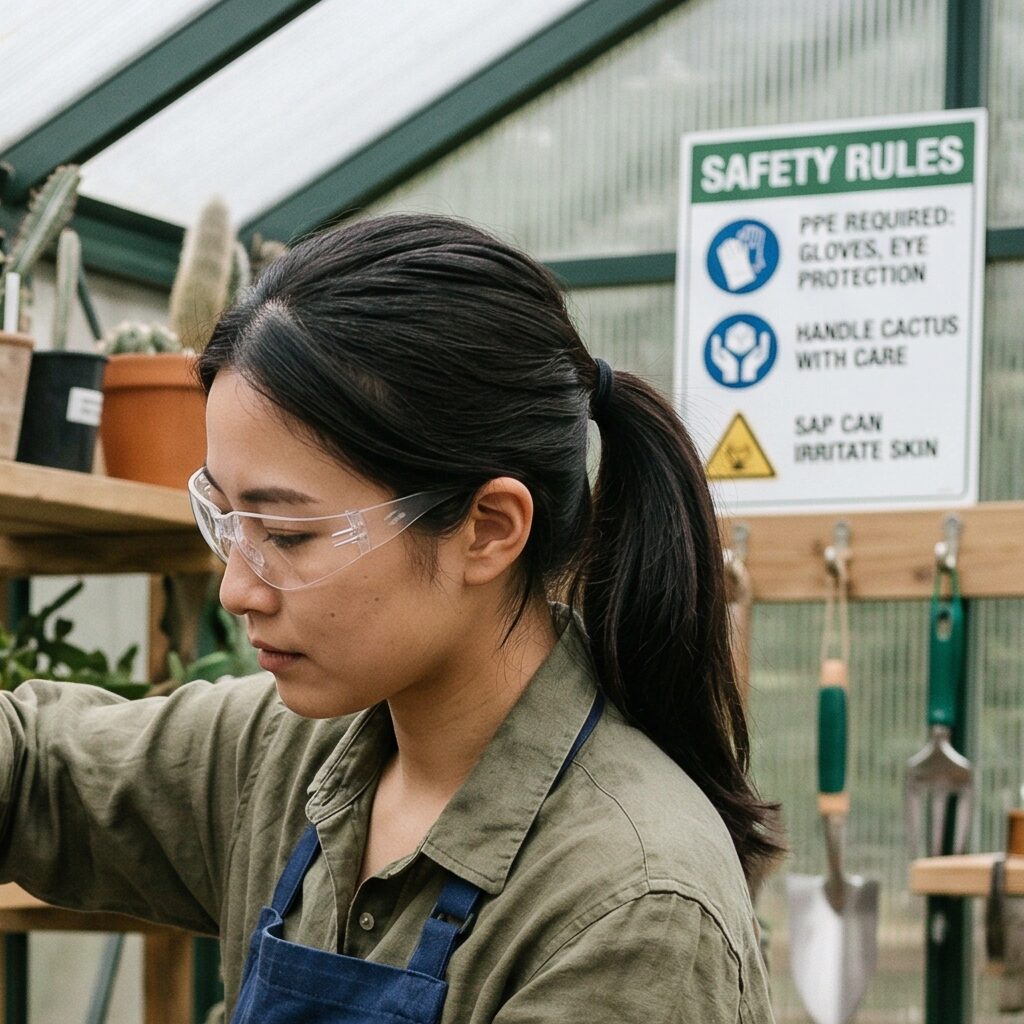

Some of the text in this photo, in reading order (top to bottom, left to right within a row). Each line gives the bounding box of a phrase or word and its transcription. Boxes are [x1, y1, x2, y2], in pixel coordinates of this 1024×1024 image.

[701, 135, 965, 194] SAFETY RULES
[799, 205, 955, 235] PPE REQUIRED:
[799, 235, 928, 263] GLOVES, EYE
[798, 264, 927, 290] PROTECTION
[796, 315, 959, 342] HANDLE CACTUS
[795, 345, 908, 370] WITH CARE
[794, 413, 883, 436] SAP CAN
[794, 438, 938, 464] IRRITATE SKIN
